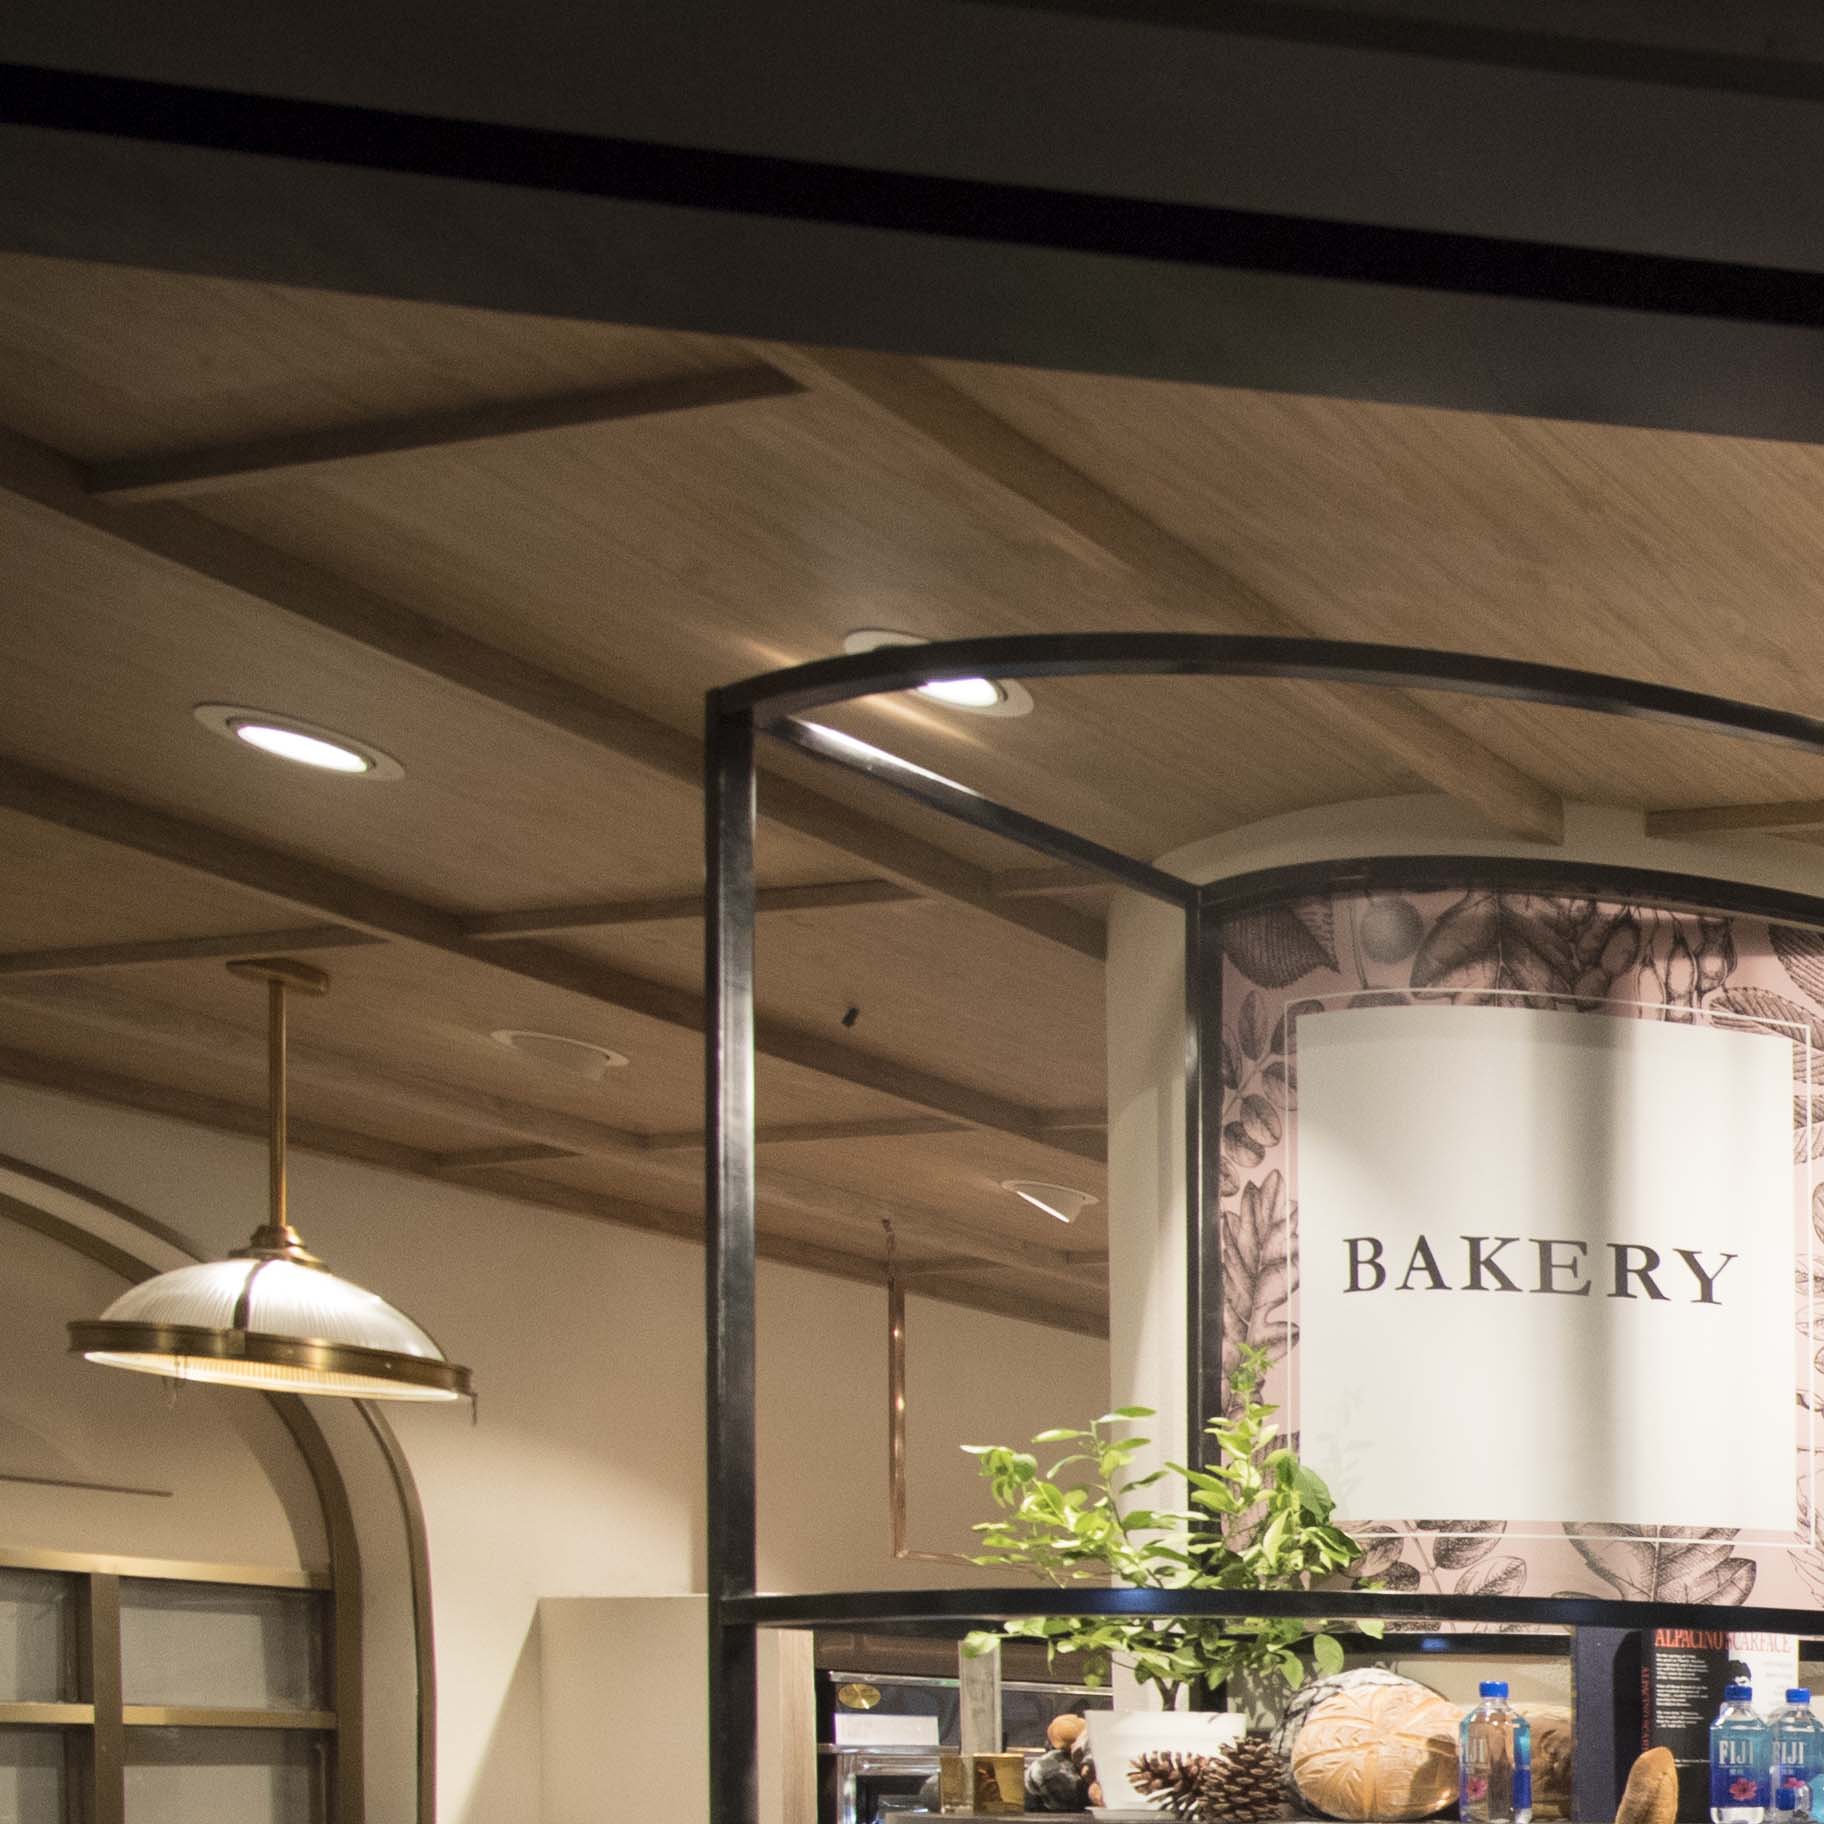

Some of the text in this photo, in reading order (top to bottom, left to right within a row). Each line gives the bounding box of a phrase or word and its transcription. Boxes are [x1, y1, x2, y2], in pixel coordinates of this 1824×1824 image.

[1342, 1234, 1738, 1306] BAKERY
[1718, 1741, 1754, 1765] FIJI
[1771, 1741, 1806, 1765] FIJI
